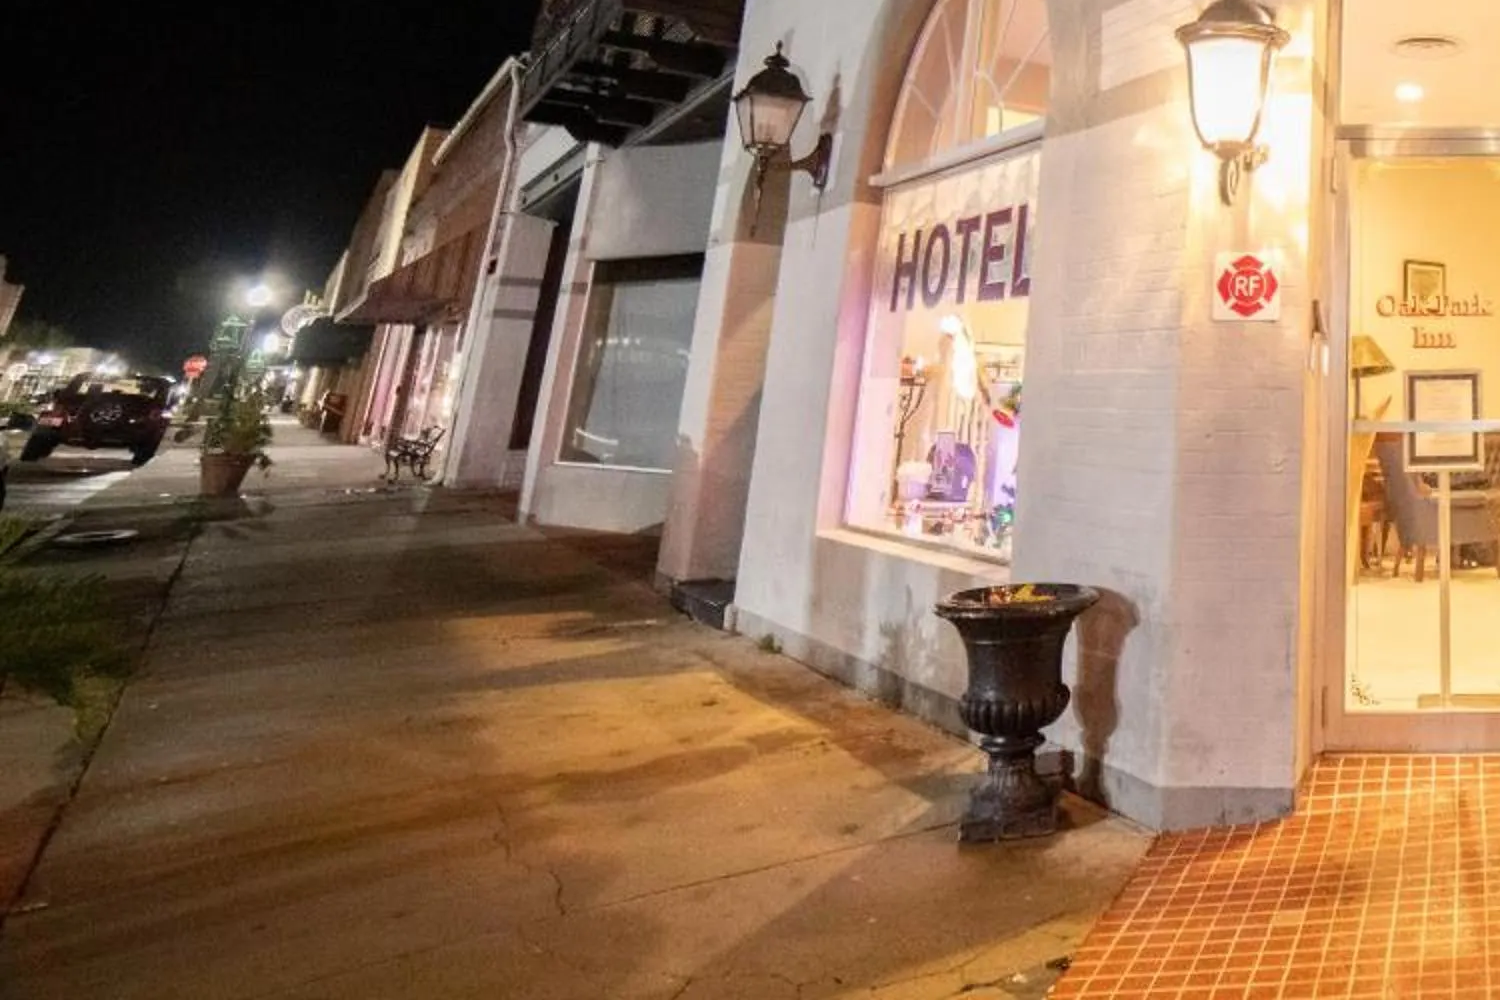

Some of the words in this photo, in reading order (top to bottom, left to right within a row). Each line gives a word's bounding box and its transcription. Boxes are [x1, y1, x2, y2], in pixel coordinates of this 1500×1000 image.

[889, 204, 1030, 313] HOTEL
[1235, 275, 1260, 297] RF
[1412, 325, 1457, 349] Inn
